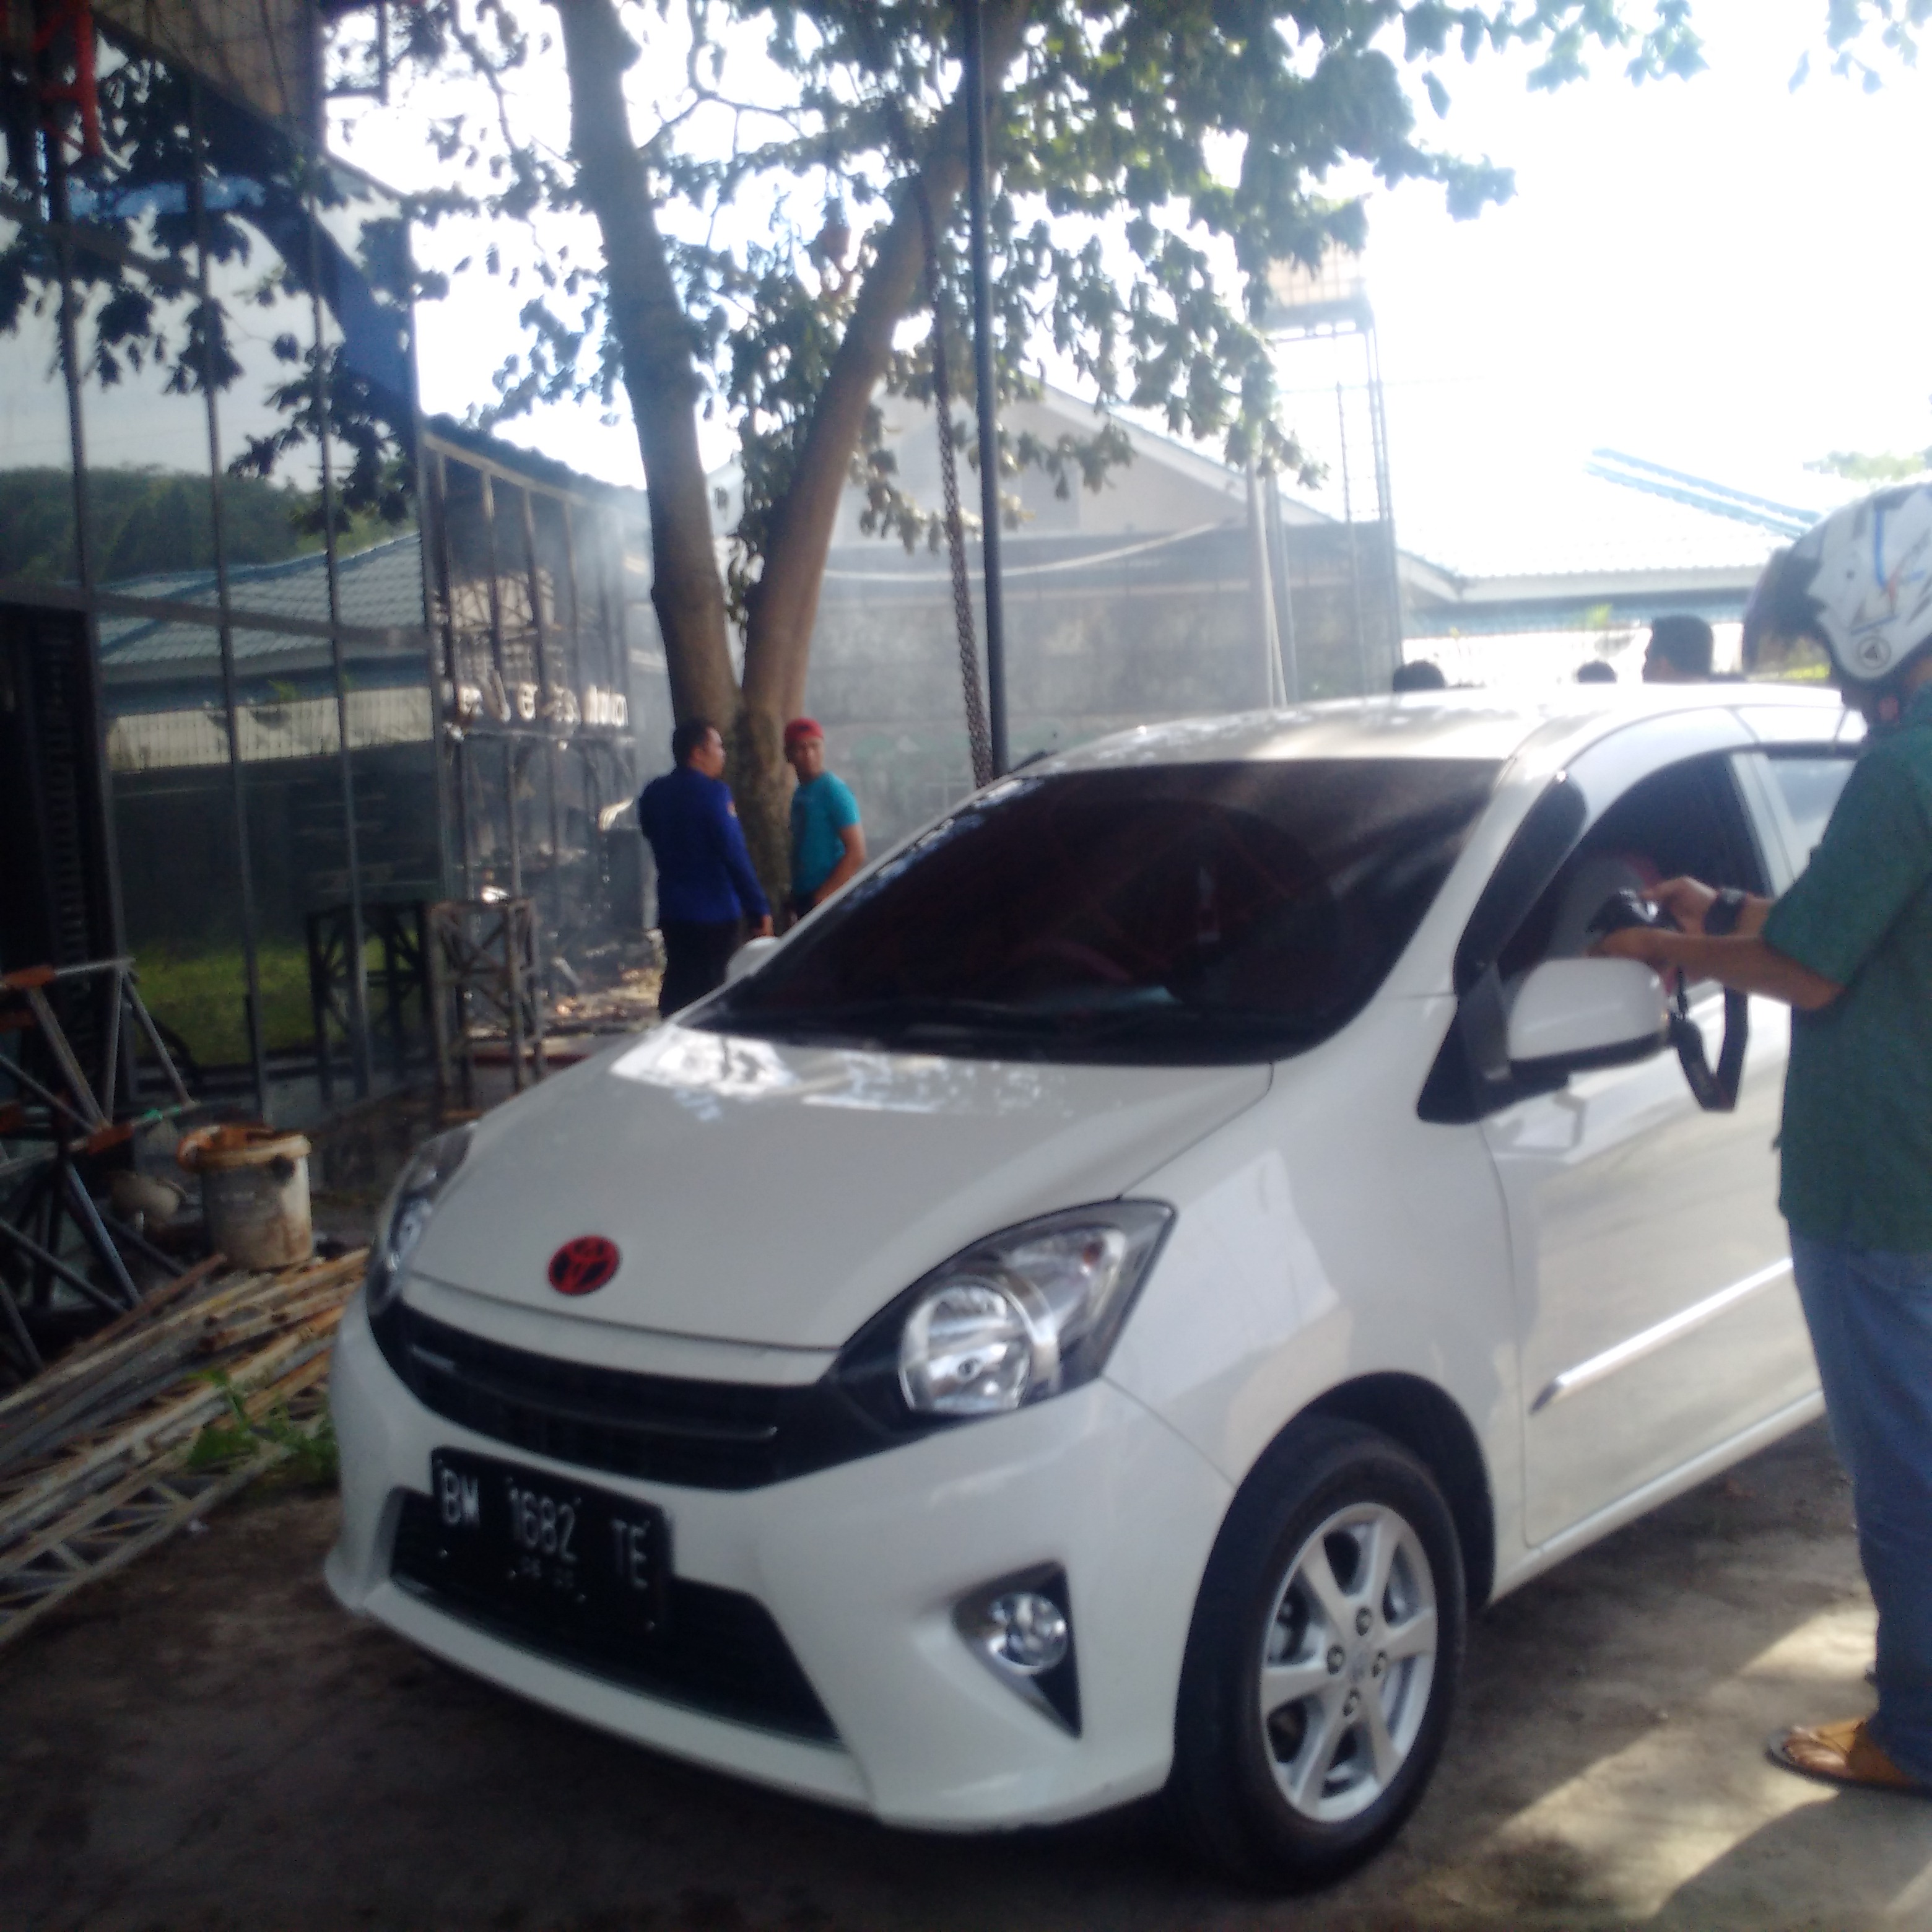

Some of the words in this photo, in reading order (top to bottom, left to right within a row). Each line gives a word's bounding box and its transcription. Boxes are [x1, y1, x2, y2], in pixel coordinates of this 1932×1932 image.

[441, 1468, 481, 1528] BM
[509, 1487, 577, 1564] 1682
[611, 1517, 648, 1590] TE
